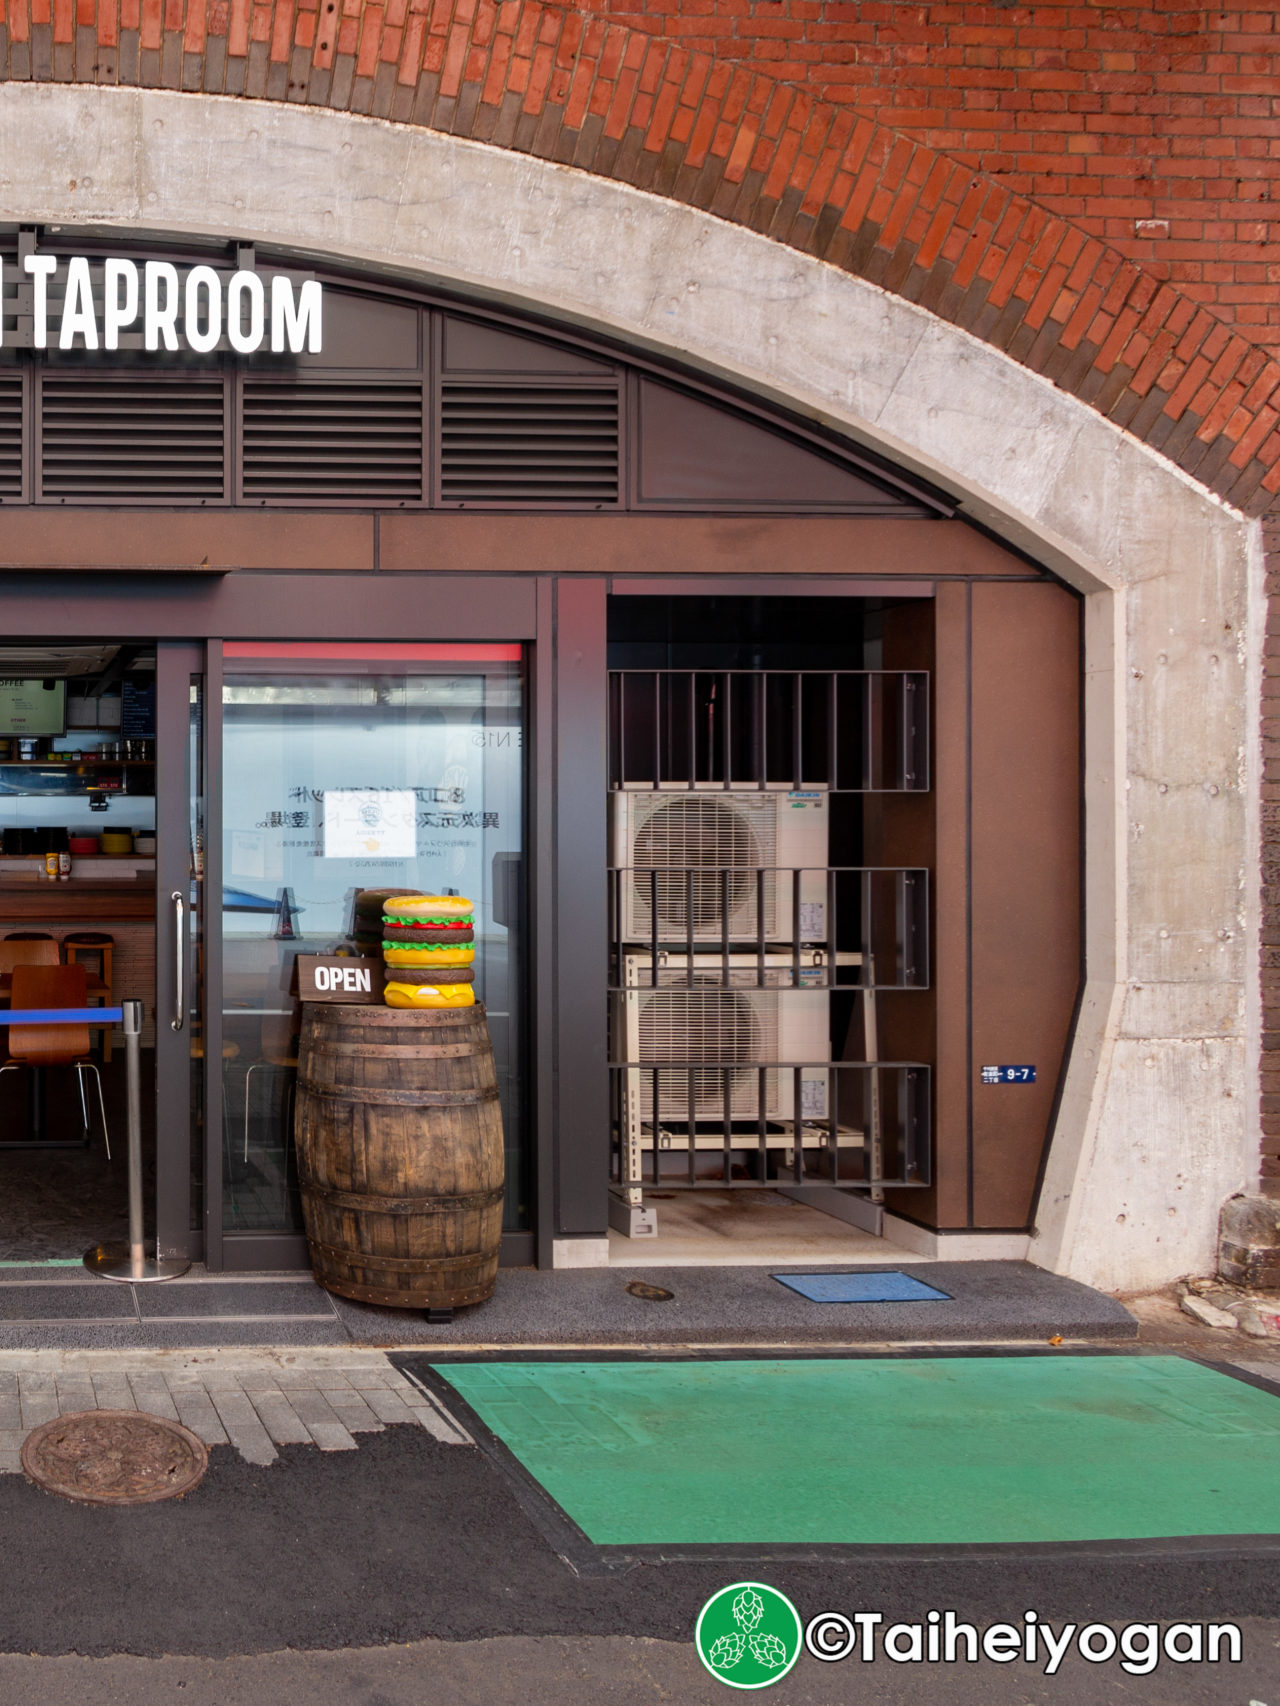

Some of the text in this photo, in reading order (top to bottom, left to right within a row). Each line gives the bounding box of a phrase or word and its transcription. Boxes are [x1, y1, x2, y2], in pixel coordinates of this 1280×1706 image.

[23, 255, 324, 353] TAPROOM
[314, 966, 371, 993] OPEN
[1007, 1068, 1029, 1080] 9-7
